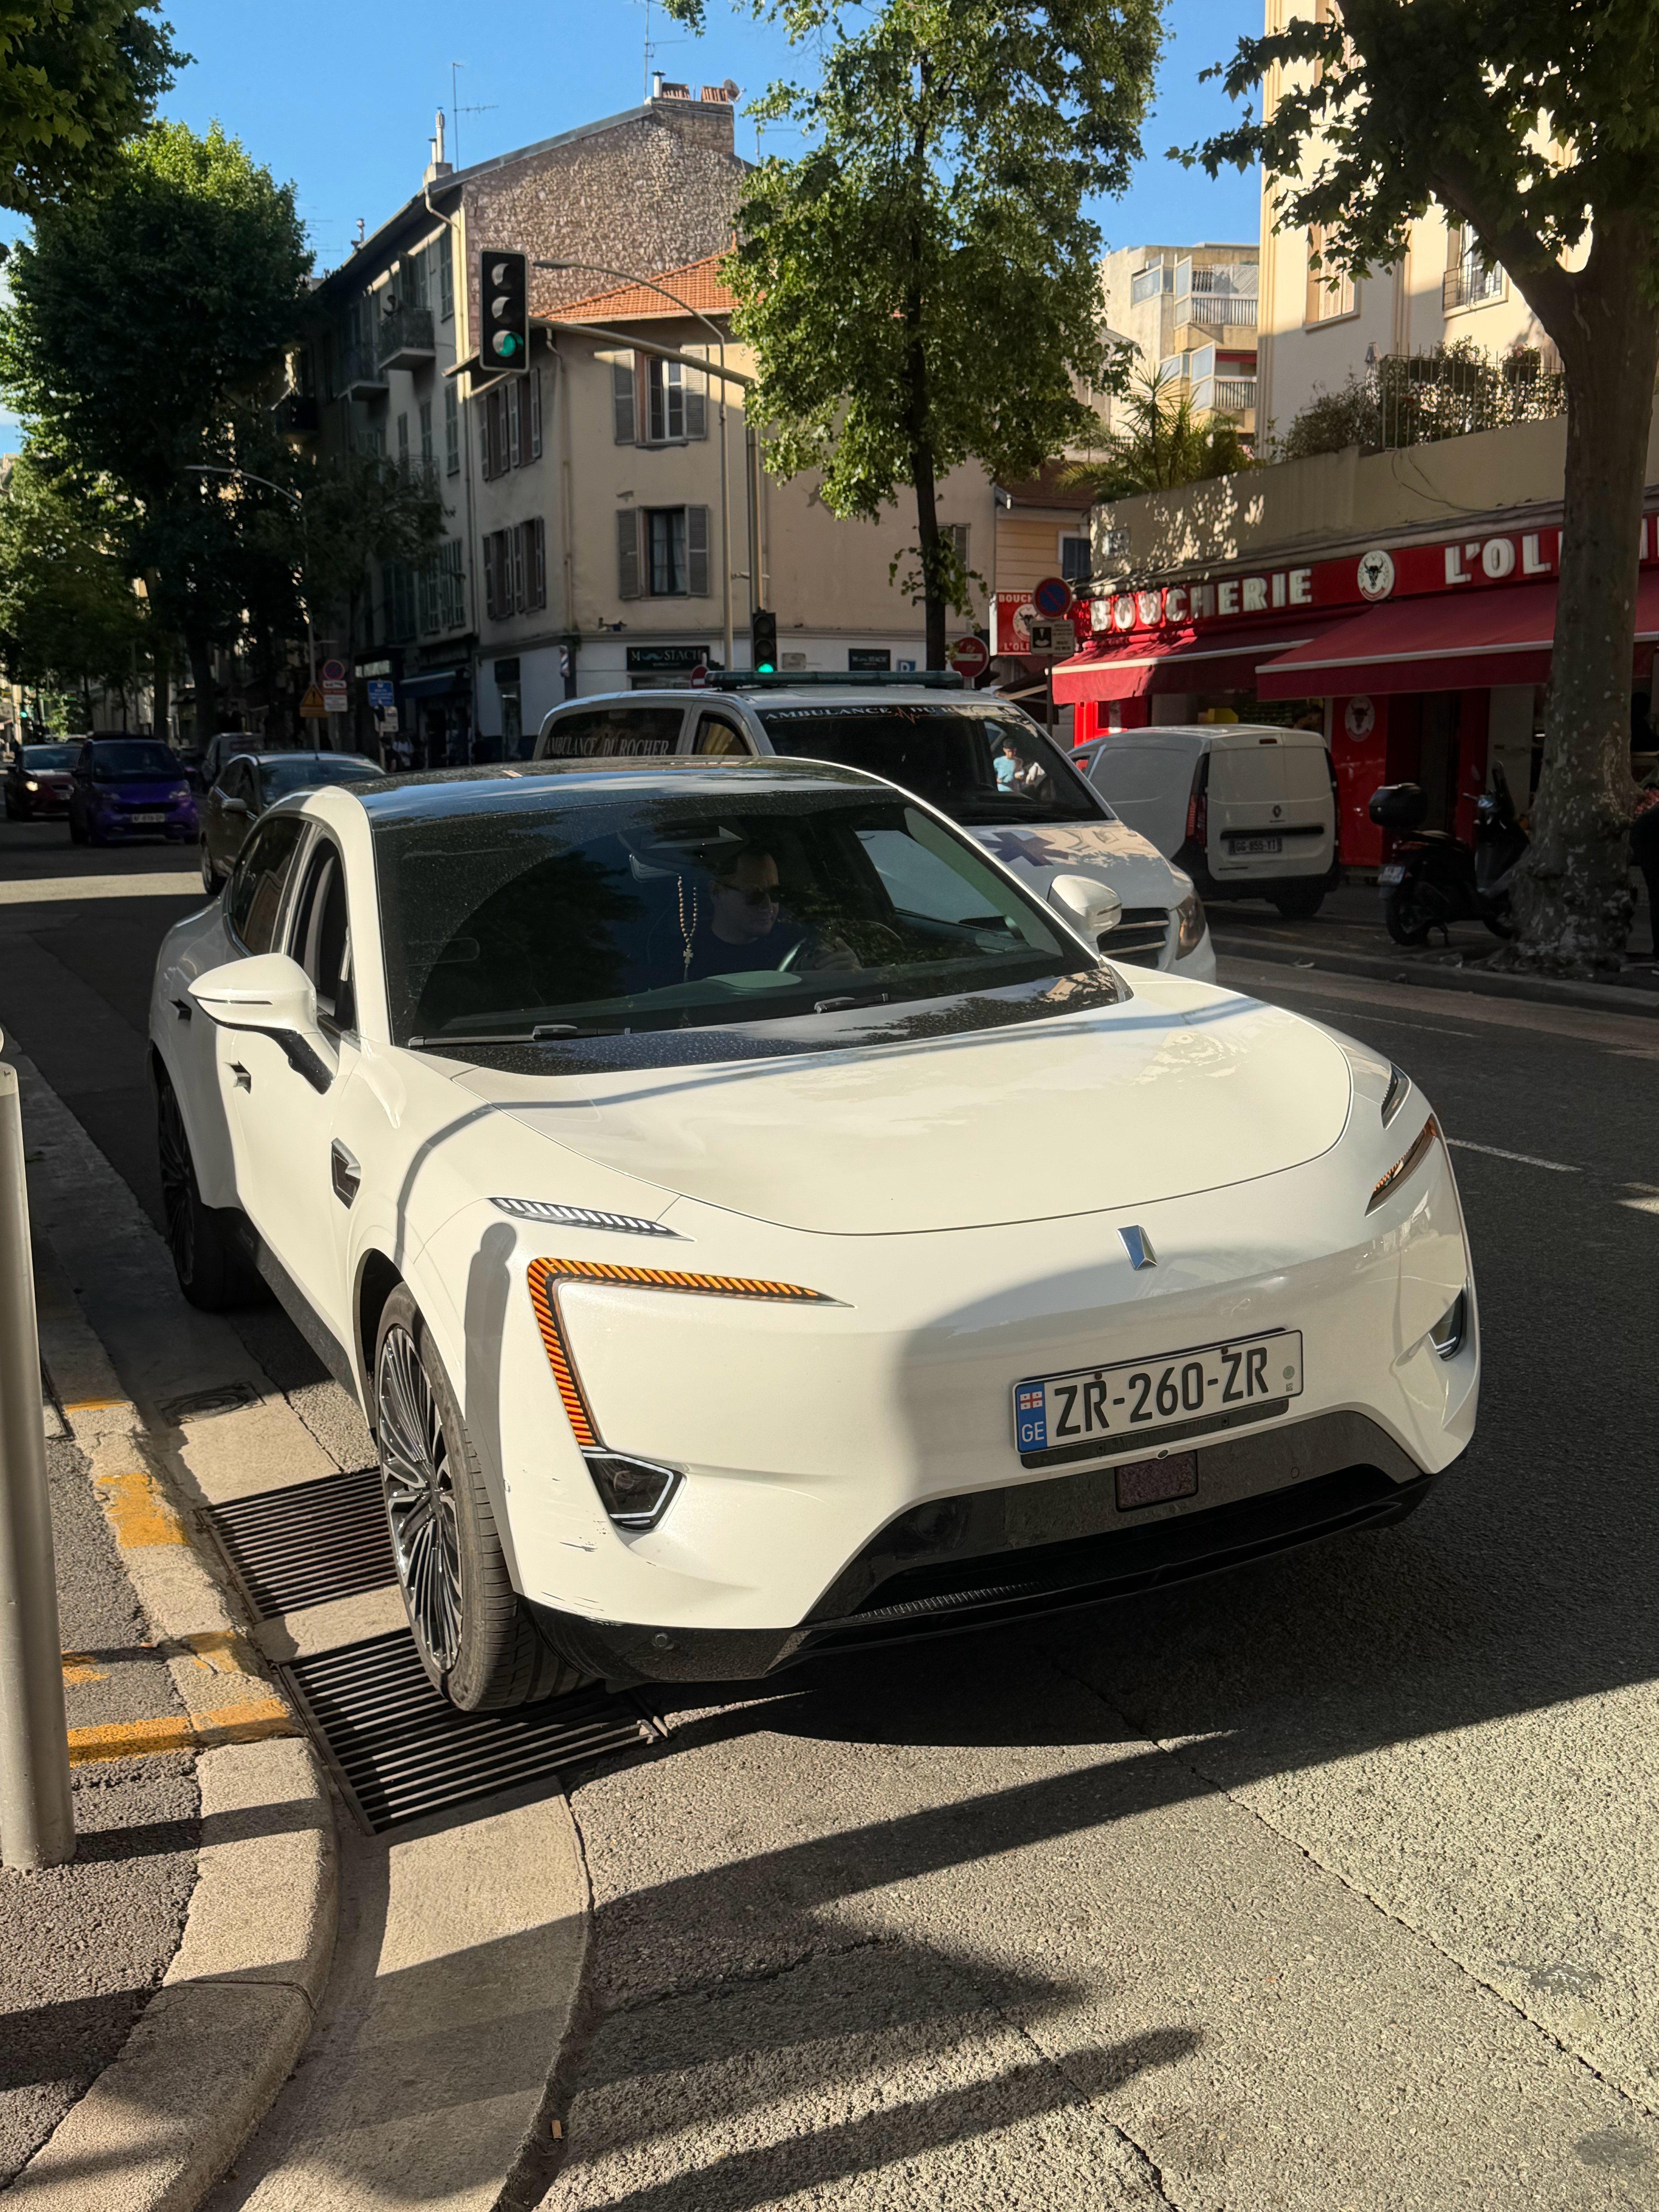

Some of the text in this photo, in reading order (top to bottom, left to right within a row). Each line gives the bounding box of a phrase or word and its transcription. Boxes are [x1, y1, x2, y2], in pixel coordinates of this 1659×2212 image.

[1090, 568, 1312, 632] BOUCHERIE
[765, 707, 891, 720] AMBULANCE
[546, 737, 670, 756] AMBULANCE DU ROCHER
[1054, 1346, 1269, 1437] ZR-260-ZR
[1021, 1421, 1045, 1443] GE
